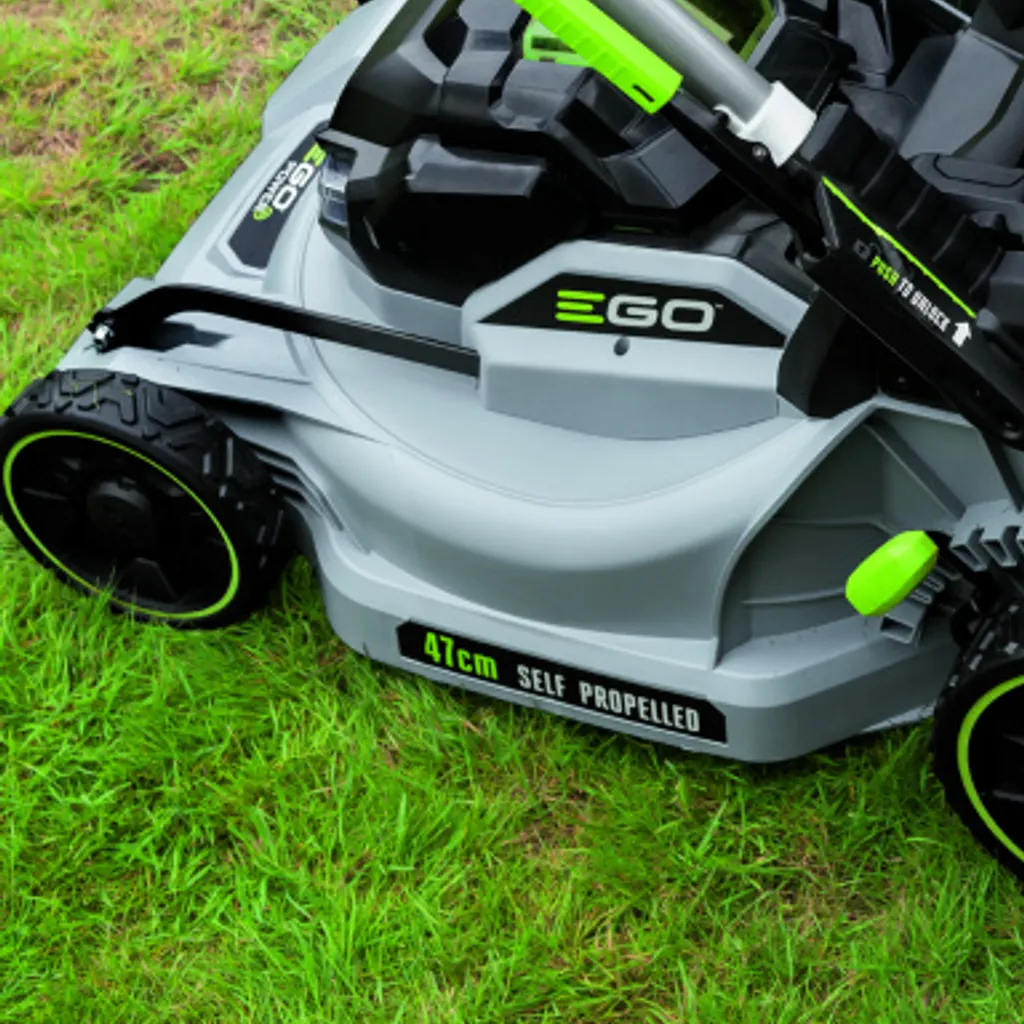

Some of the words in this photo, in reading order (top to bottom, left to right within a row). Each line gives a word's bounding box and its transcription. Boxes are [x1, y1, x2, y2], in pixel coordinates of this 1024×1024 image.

[273, 142, 326, 212] EGO
[555, 289, 715, 332] EGO
[898, 277, 914, 297] TO
[424, 631, 498, 680] 47cm
[516, 664, 567, 698] SELF
[578, 680, 700, 733] PROPELLED
